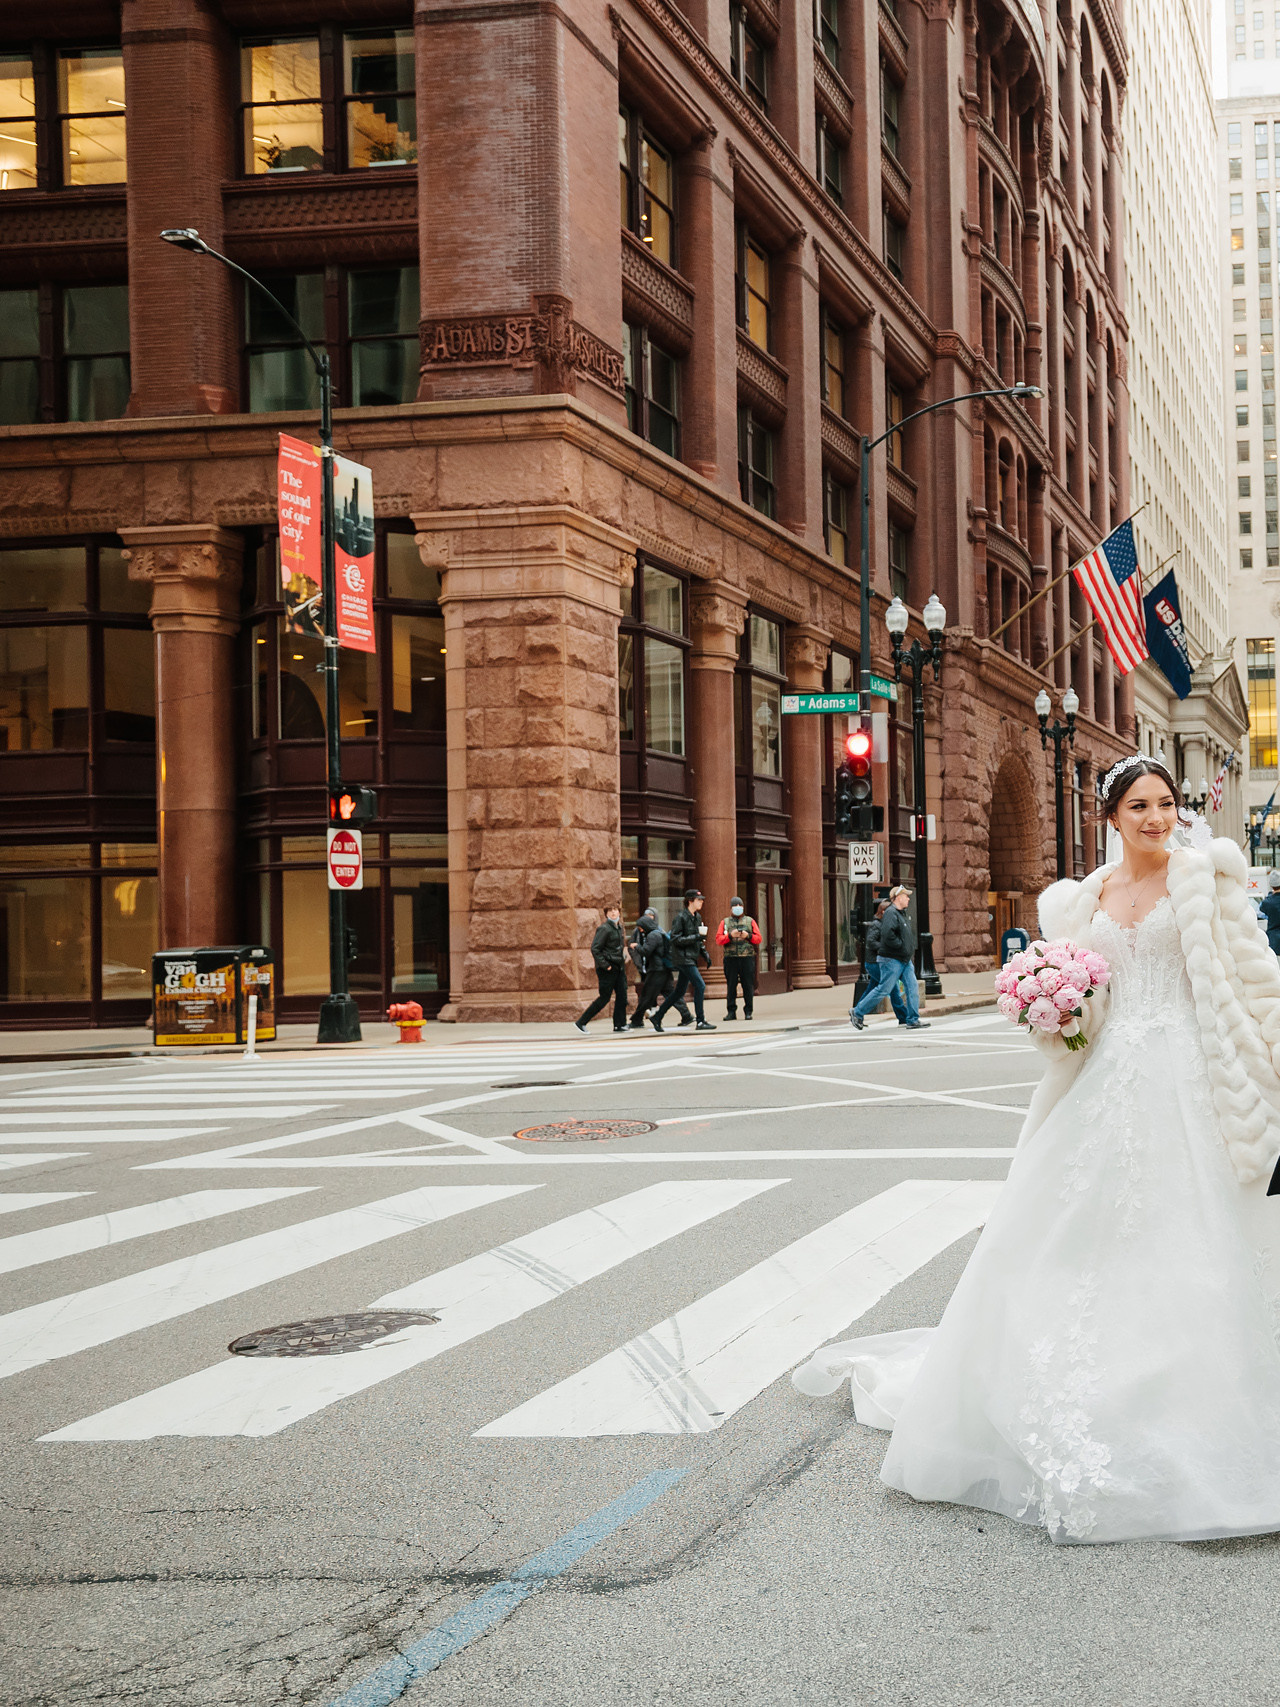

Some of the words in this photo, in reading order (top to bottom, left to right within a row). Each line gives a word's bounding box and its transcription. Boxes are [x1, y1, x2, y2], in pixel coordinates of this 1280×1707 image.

[433, 326, 505, 360] ADAMS
[280, 470, 302, 488] The
[281, 491, 311, 508] sound
[281, 507, 293, 519] of
[294, 514, 312, 525] our
[282, 523, 304, 542] city.
[871, 678, 877, 690] La
[877, 680, 888, 694] Salle
[808, 697, 846, 709] Adams
[848, 698, 856, 706] St
[333, 841, 342, 851] DO
[344, 842, 357, 852] NOT
[853, 846, 875, 855] ONE
[853, 857, 875, 866] WAY
[336, 866, 355, 877] ENTER
[164, 965, 197, 975] van
[164, 972, 226, 988] GOGH
[195, 987, 226, 995] Chicago
